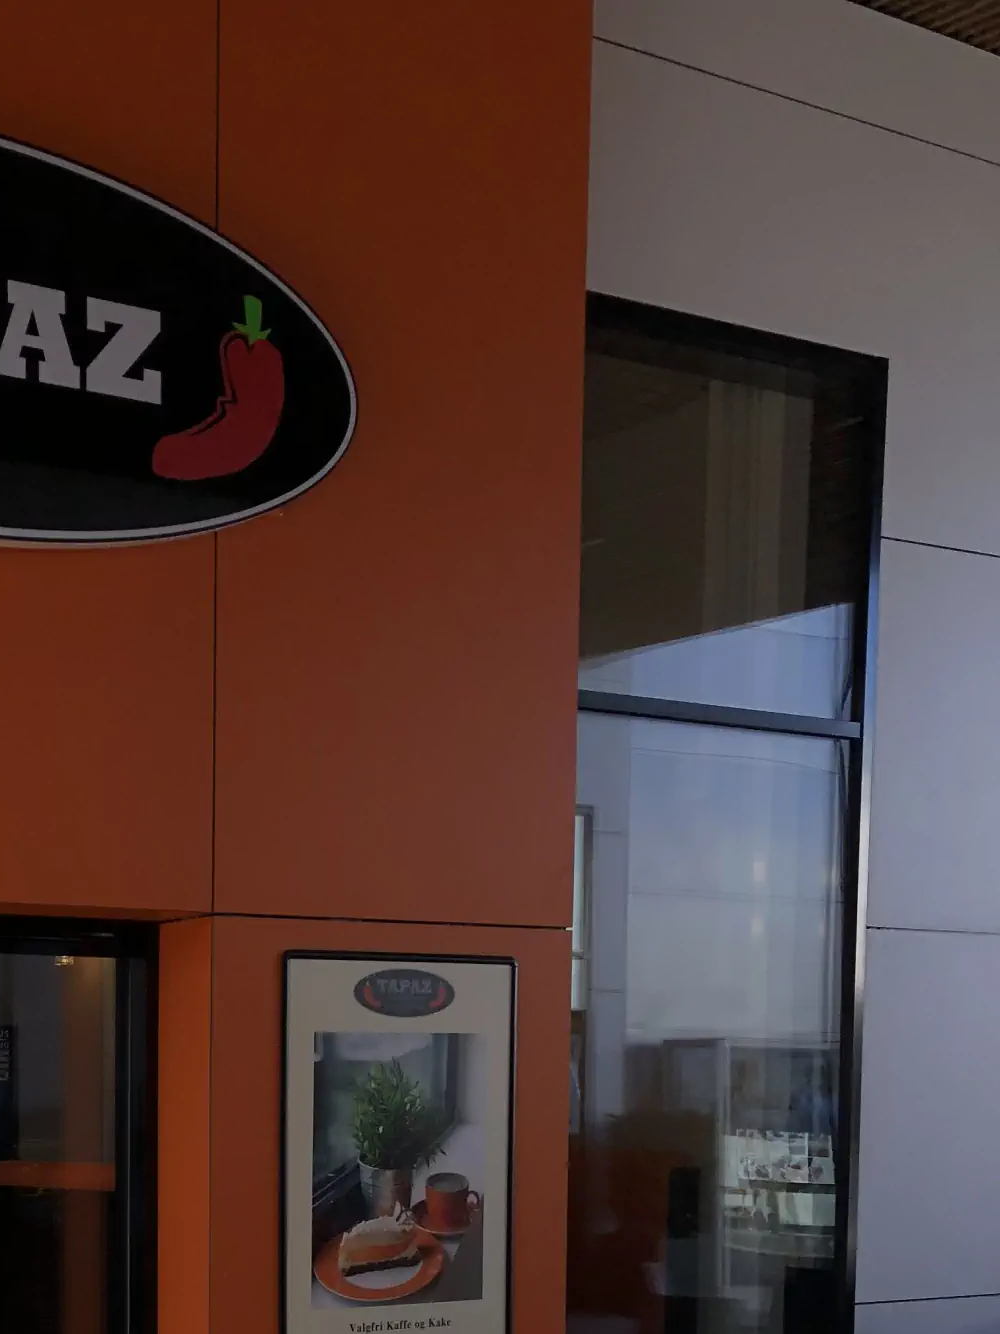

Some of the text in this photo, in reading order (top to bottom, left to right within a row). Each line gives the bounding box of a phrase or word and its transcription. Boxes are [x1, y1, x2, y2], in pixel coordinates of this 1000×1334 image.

[349, 1317, 452, 1334] Valgfri Kaffe og Kake
